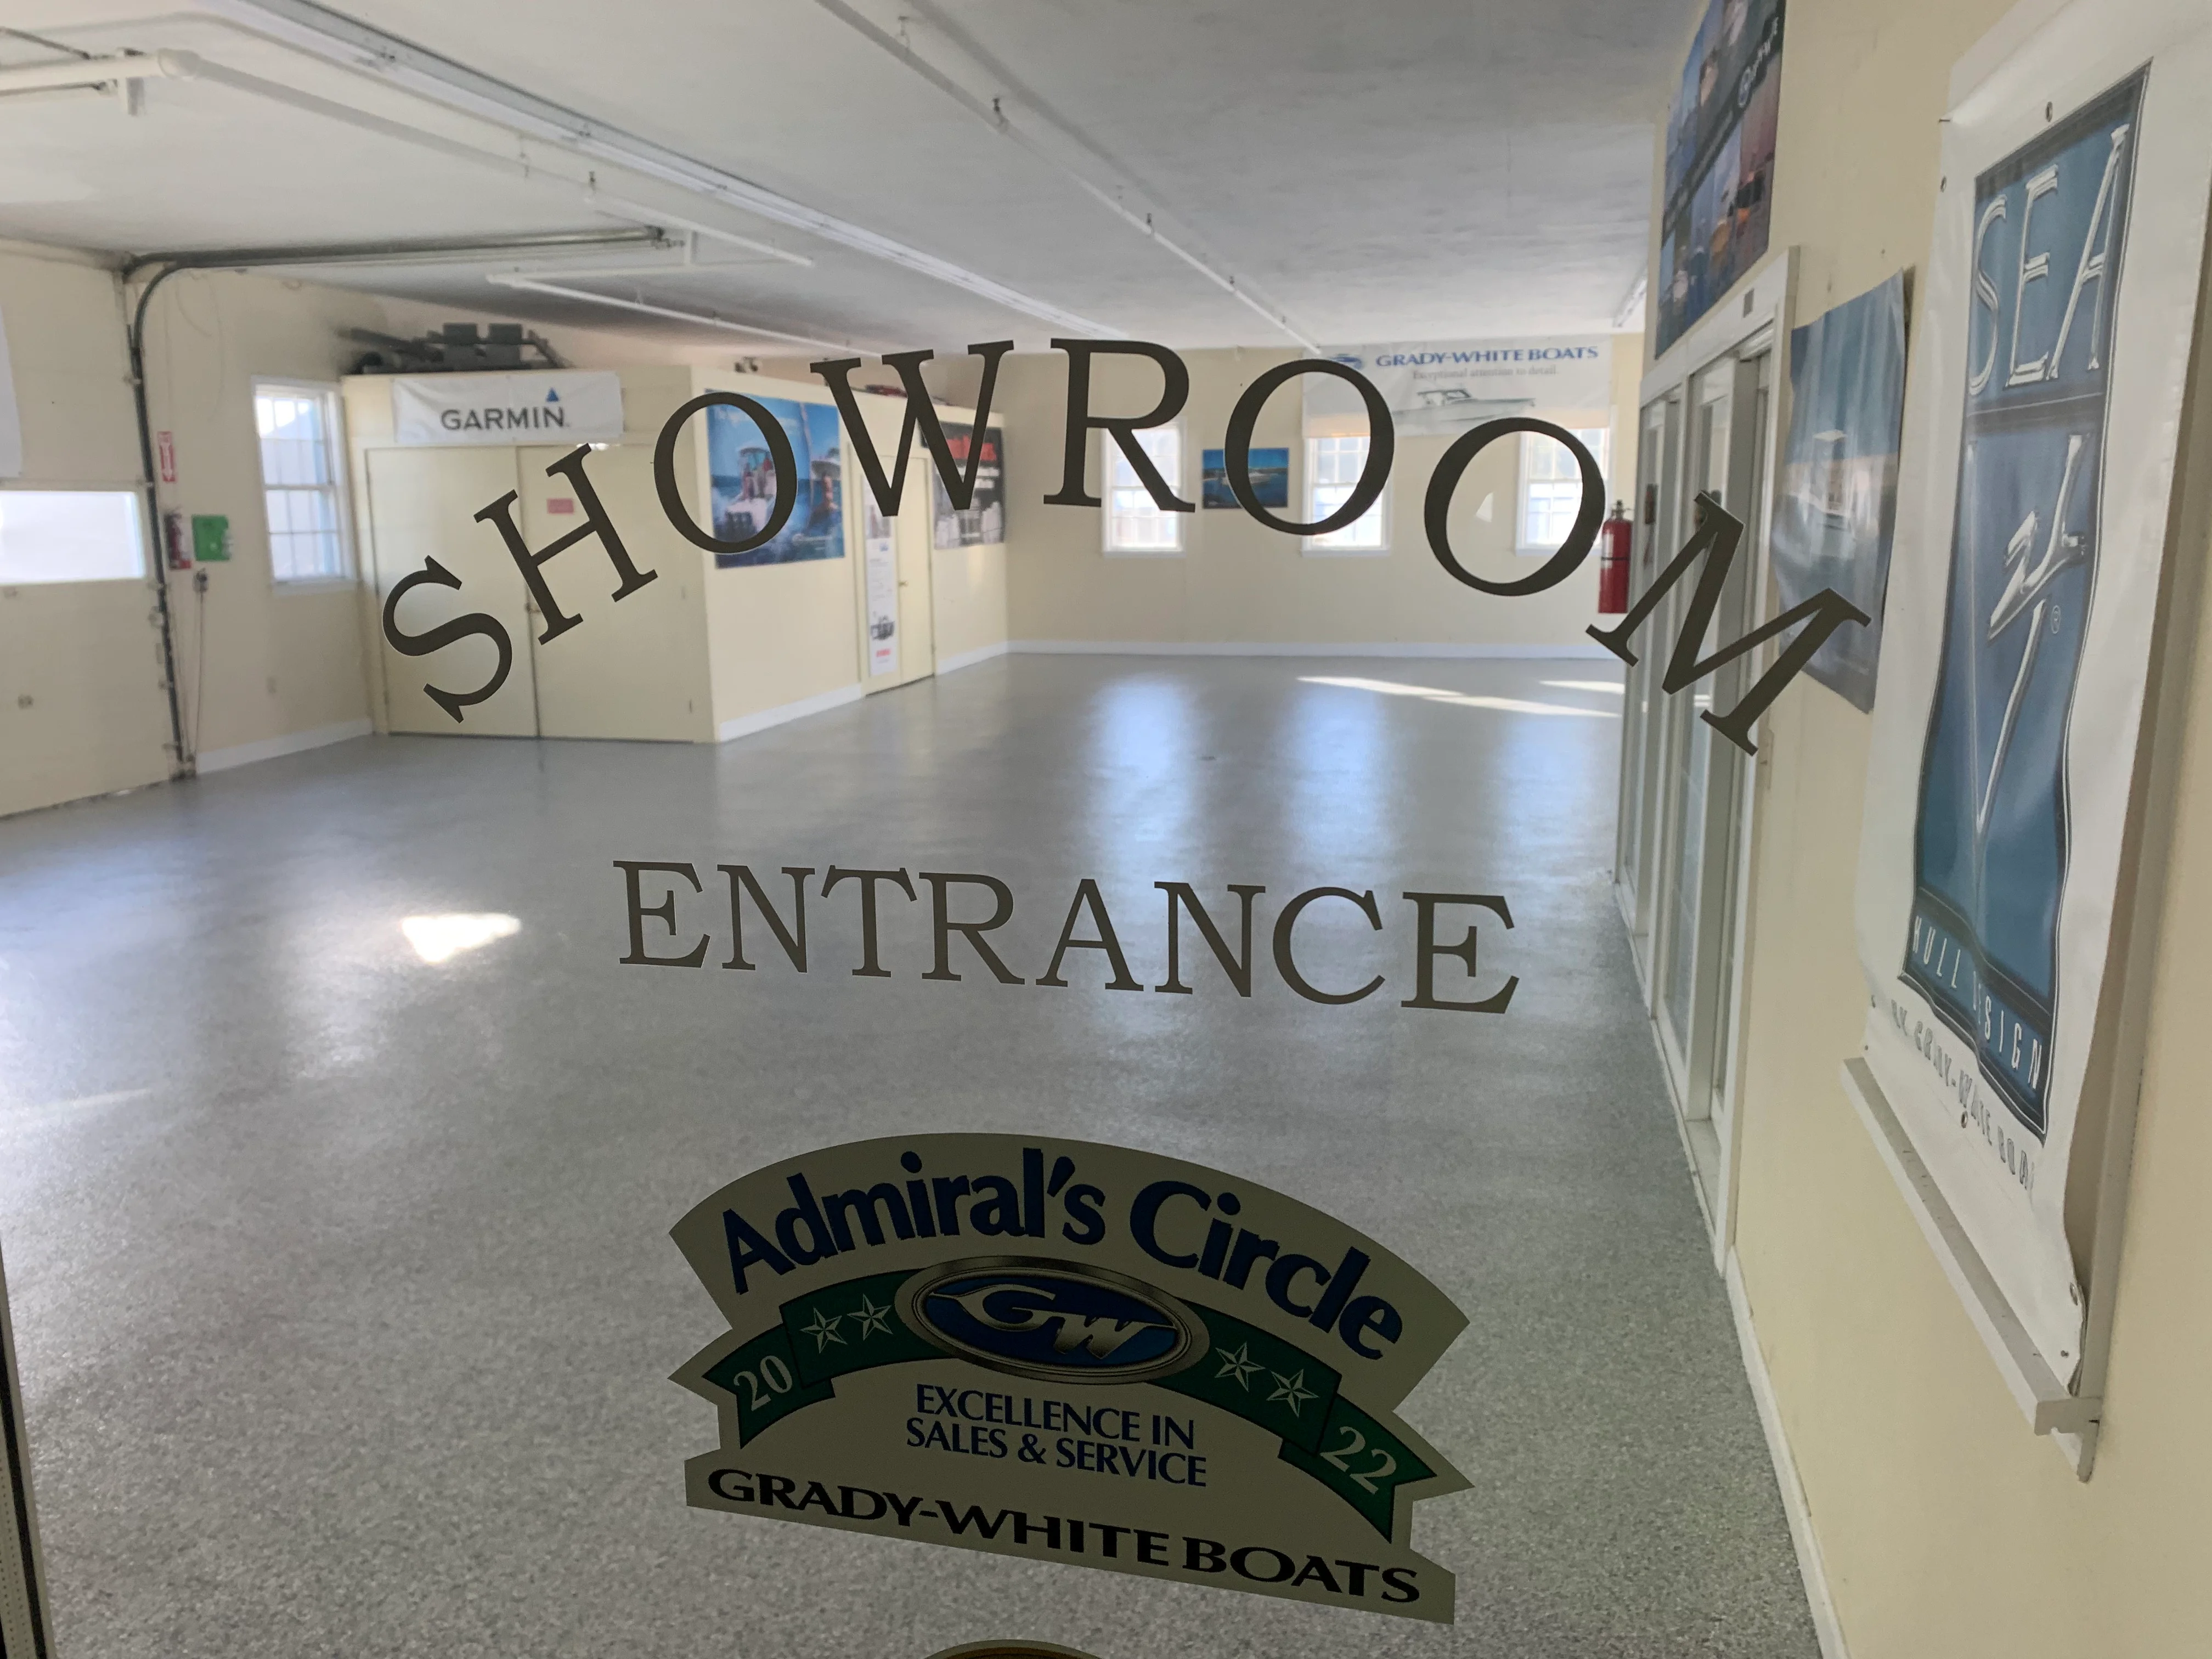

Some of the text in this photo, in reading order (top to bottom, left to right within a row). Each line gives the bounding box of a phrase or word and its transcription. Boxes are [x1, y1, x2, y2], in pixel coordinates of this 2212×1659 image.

[1968, 124, 2129, 396] SEA
[1376, 349, 1524, 366] GRADY-WHITE
[1528, 346, 1599, 360] BOATS
[441, 406, 565, 431] GARMIN
[382, 337, 1872, 757] SHOWROOM
[613, 860, 1520, 1014] ENTRANCE
[1912, 916, 1961, 989] HULL
[723, 1148, 1402, 1360] Admiral's Circle
[733, 1355, 792, 1411] 20
[917, 1384, 1194, 1449] EXCELLENCE IN
[906, 1418, 1206, 1487] SALES & SERVICE
[1319, 1426, 1397, 1494] 22
[708, 1469, 1420, 1603] GRADY-WHITE BOATS
